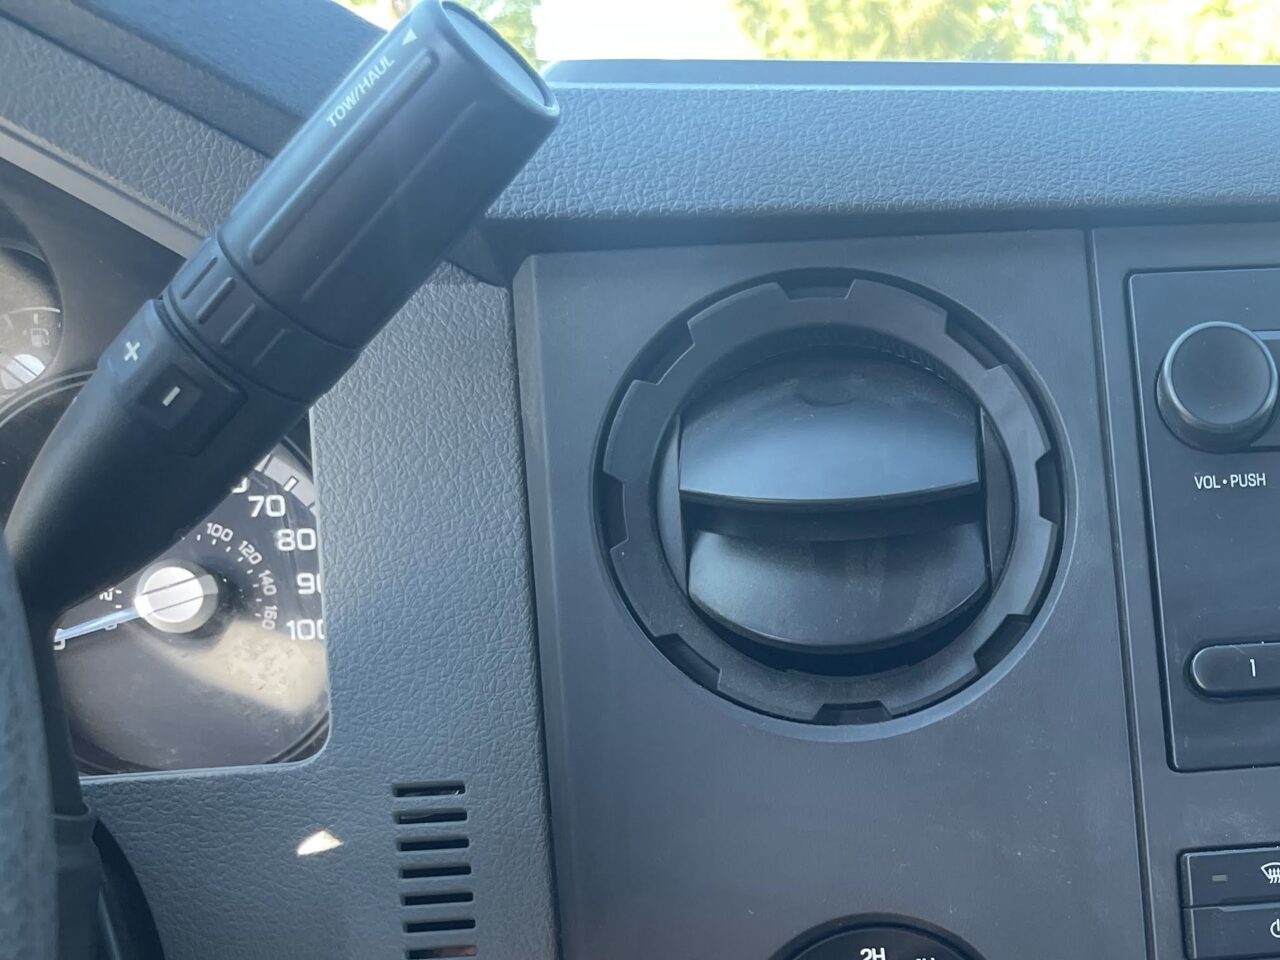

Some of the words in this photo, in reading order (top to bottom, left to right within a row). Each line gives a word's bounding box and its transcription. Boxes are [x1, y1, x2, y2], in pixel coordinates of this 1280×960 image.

[326, 55, 395, 127] TOW/HAUL
[1194, 475, 1221, 490] VOL
[1230, 473, 1266, 488] PUSH
[248, 494, 286, 517] 70
[206, 522, 234, 542] 100
[276, 528, 316, 551] 80
[238, 540, 263, 565] 120
[258, 569, 277, 596] 140
[296, 572, 321, 595] 9
[261, 605, 278, 630] 160
[1249, 658, 1256, 677] 1
